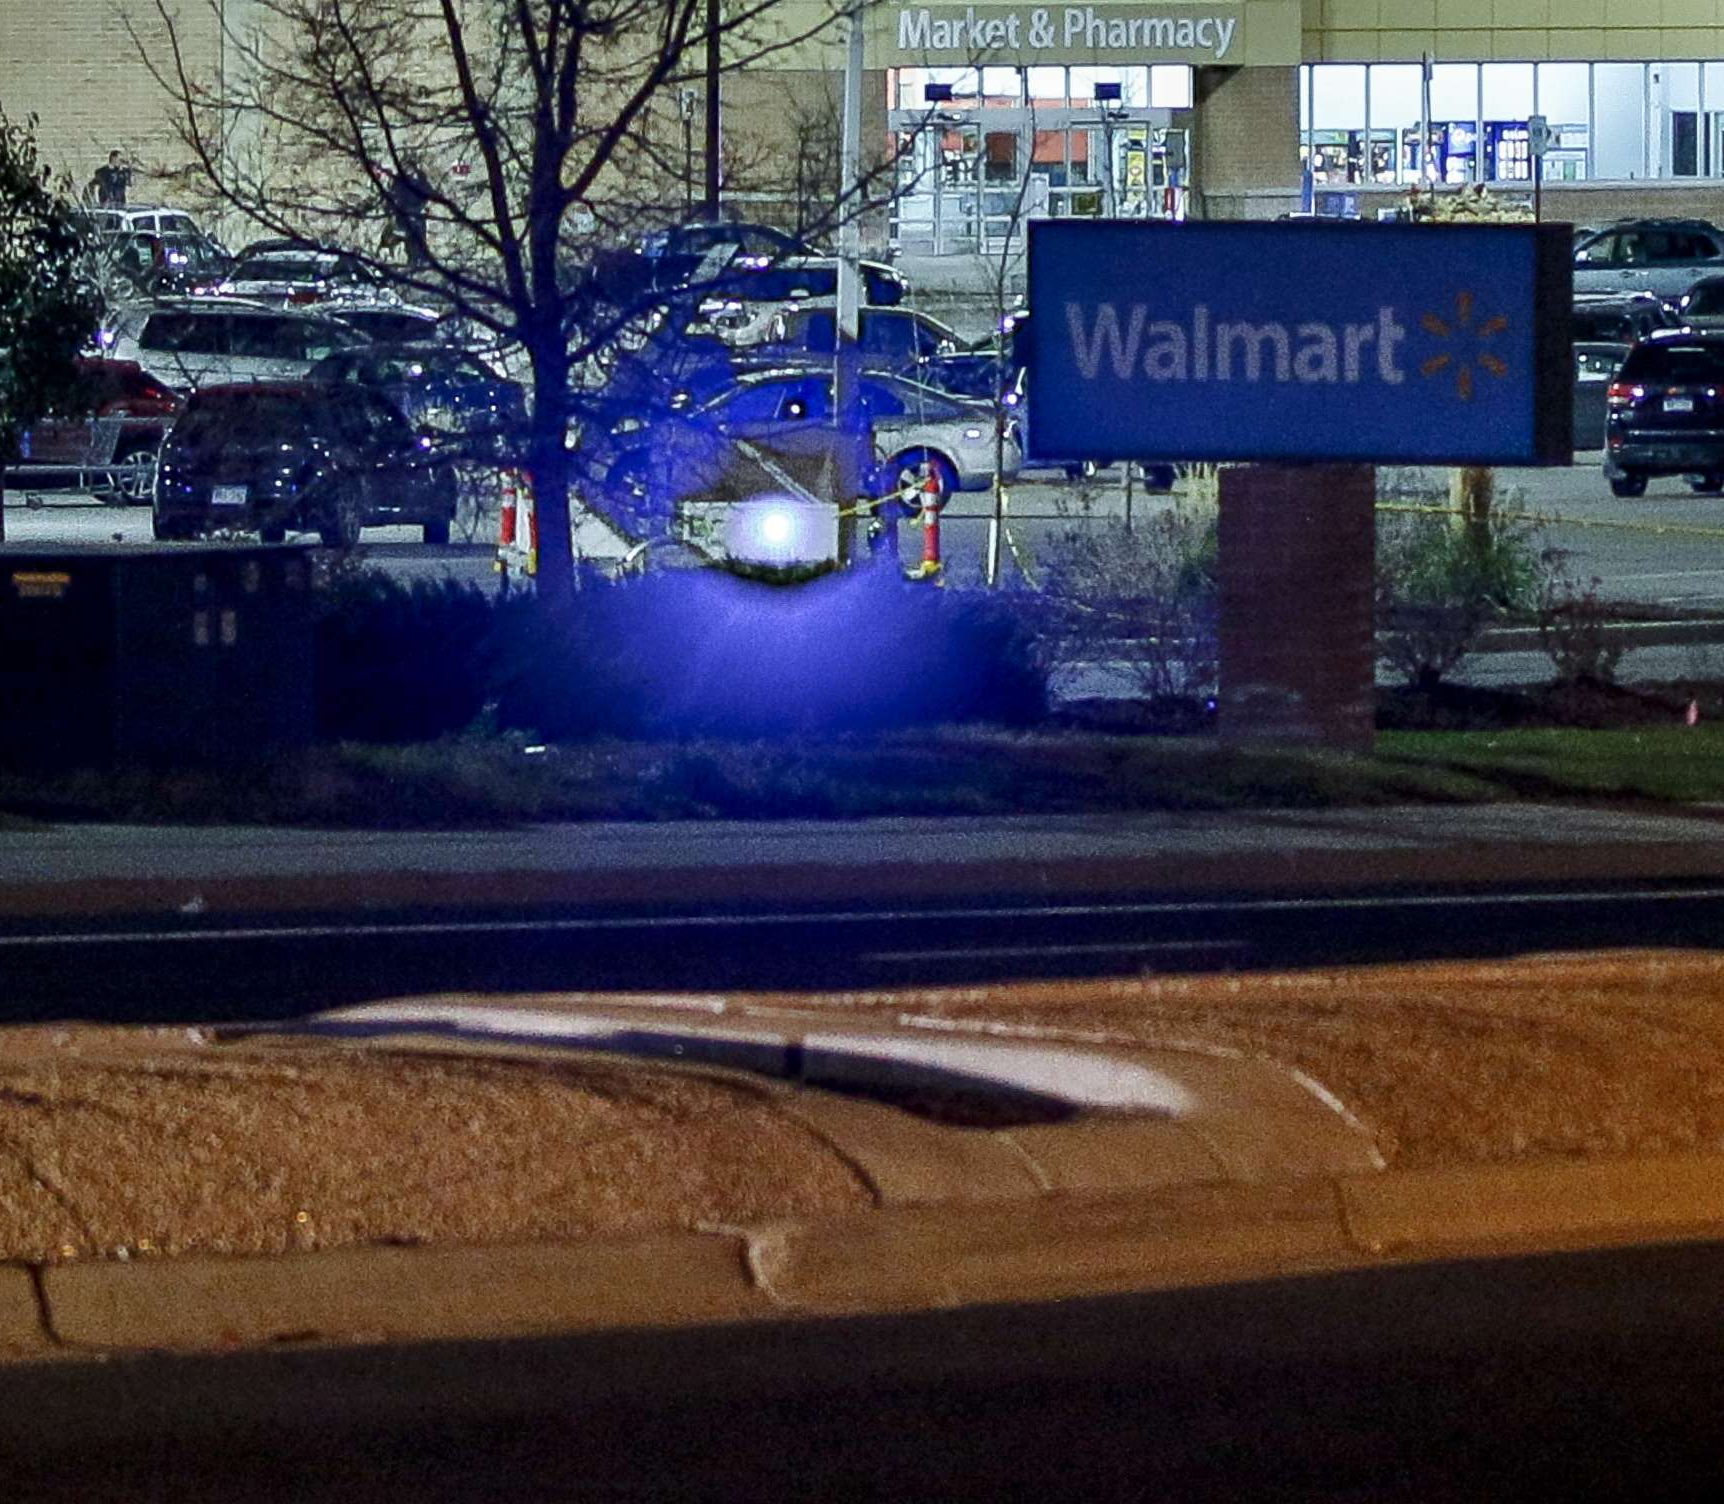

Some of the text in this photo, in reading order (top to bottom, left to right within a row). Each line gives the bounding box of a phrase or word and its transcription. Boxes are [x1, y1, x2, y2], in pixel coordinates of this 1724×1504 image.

[898, 7, 1236, 58] Market & Pharmacy
[1065, 302, 1406, 385] Walmart
